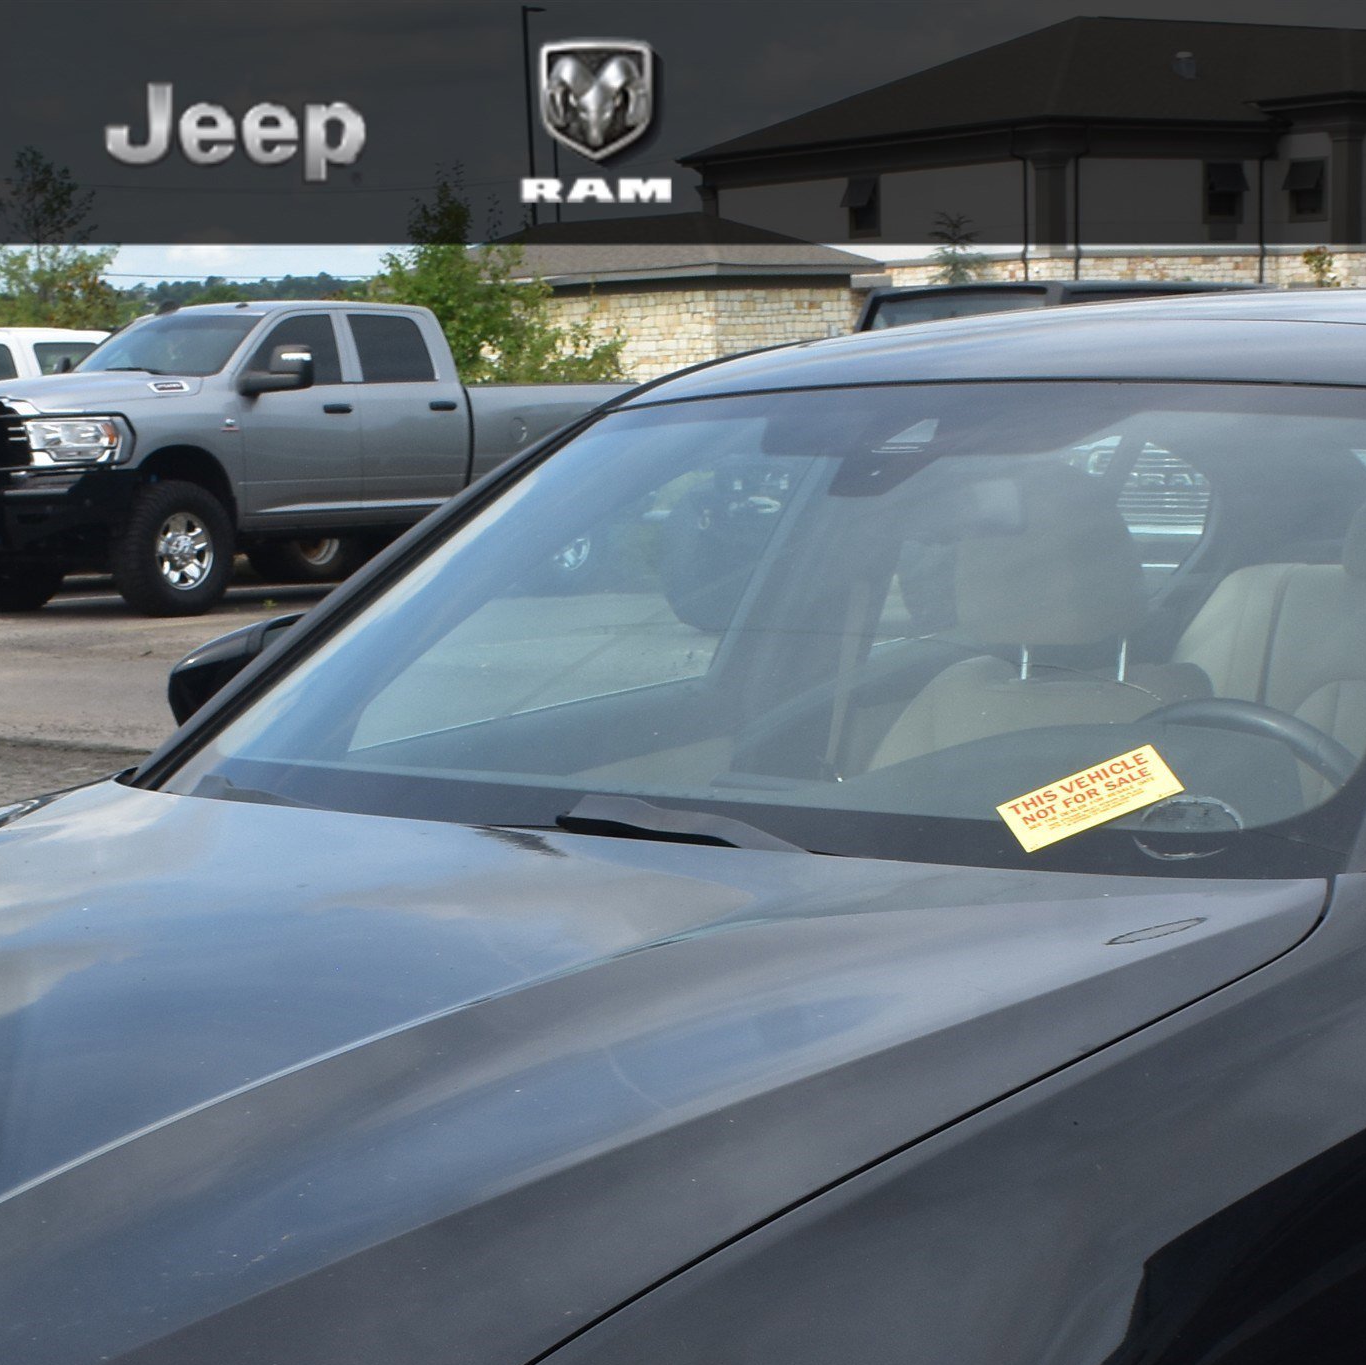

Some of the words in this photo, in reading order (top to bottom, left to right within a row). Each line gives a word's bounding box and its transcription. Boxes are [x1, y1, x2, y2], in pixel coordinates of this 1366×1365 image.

[1008, 788, 1058, 816] THIS
[1059, 752, 1148, 795] VEHICLE
[1021, 804, 1058, 825] NOT
[1062, 787, 1100, 808] FOR
[1103, 767, 1151, 791] SALE
